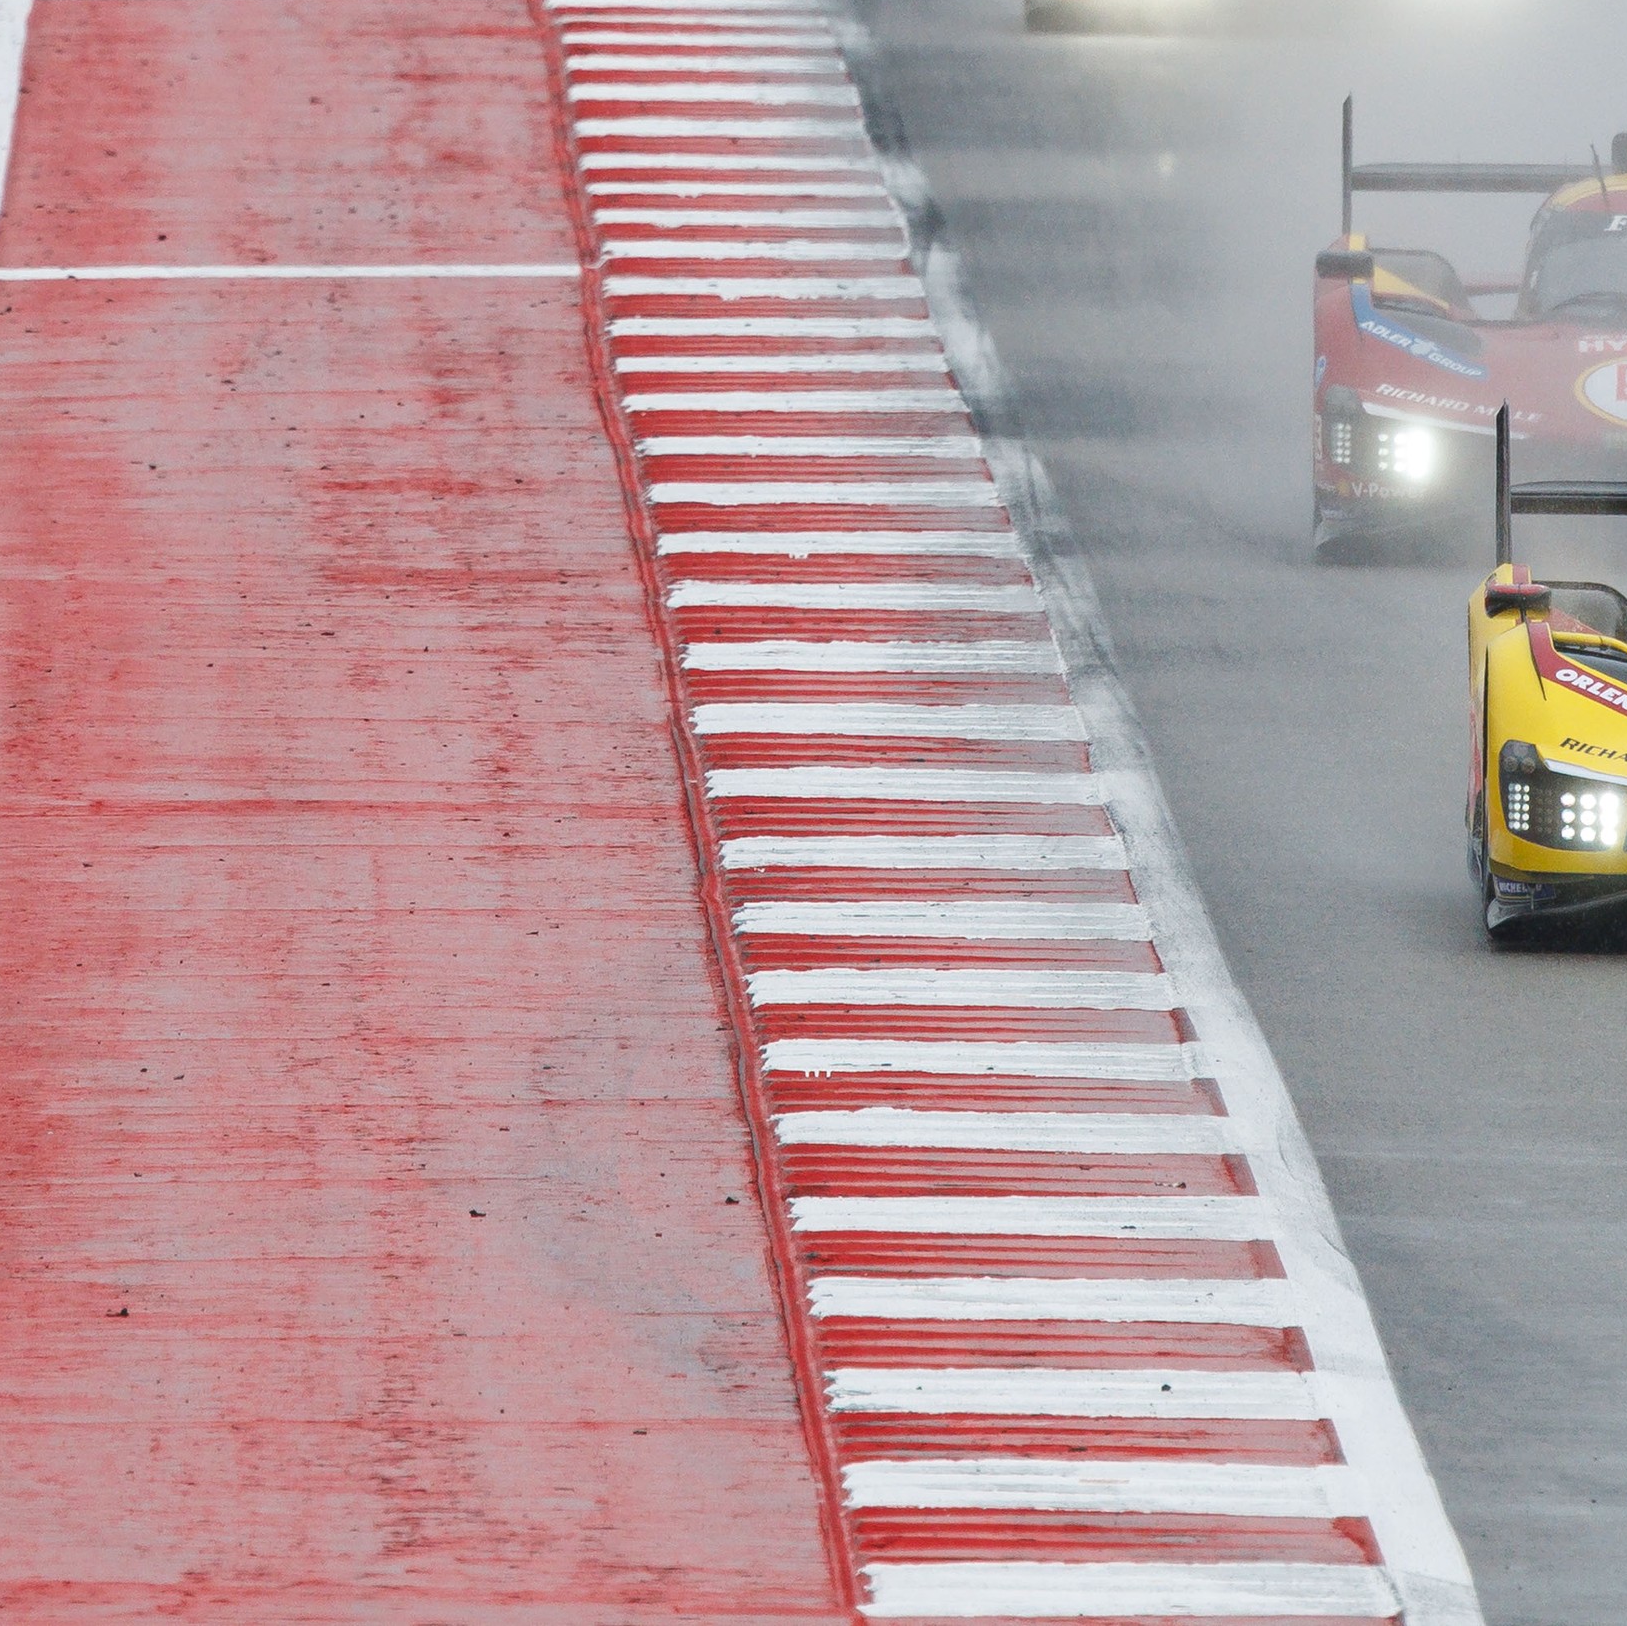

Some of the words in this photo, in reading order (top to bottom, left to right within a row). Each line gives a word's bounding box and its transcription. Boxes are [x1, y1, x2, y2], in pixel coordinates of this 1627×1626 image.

[1359, 320, 1412, 348] ADLER
[1428, 351, 1485, 377] GROUP
[1375, 383, 1469, 411] RICHARD
